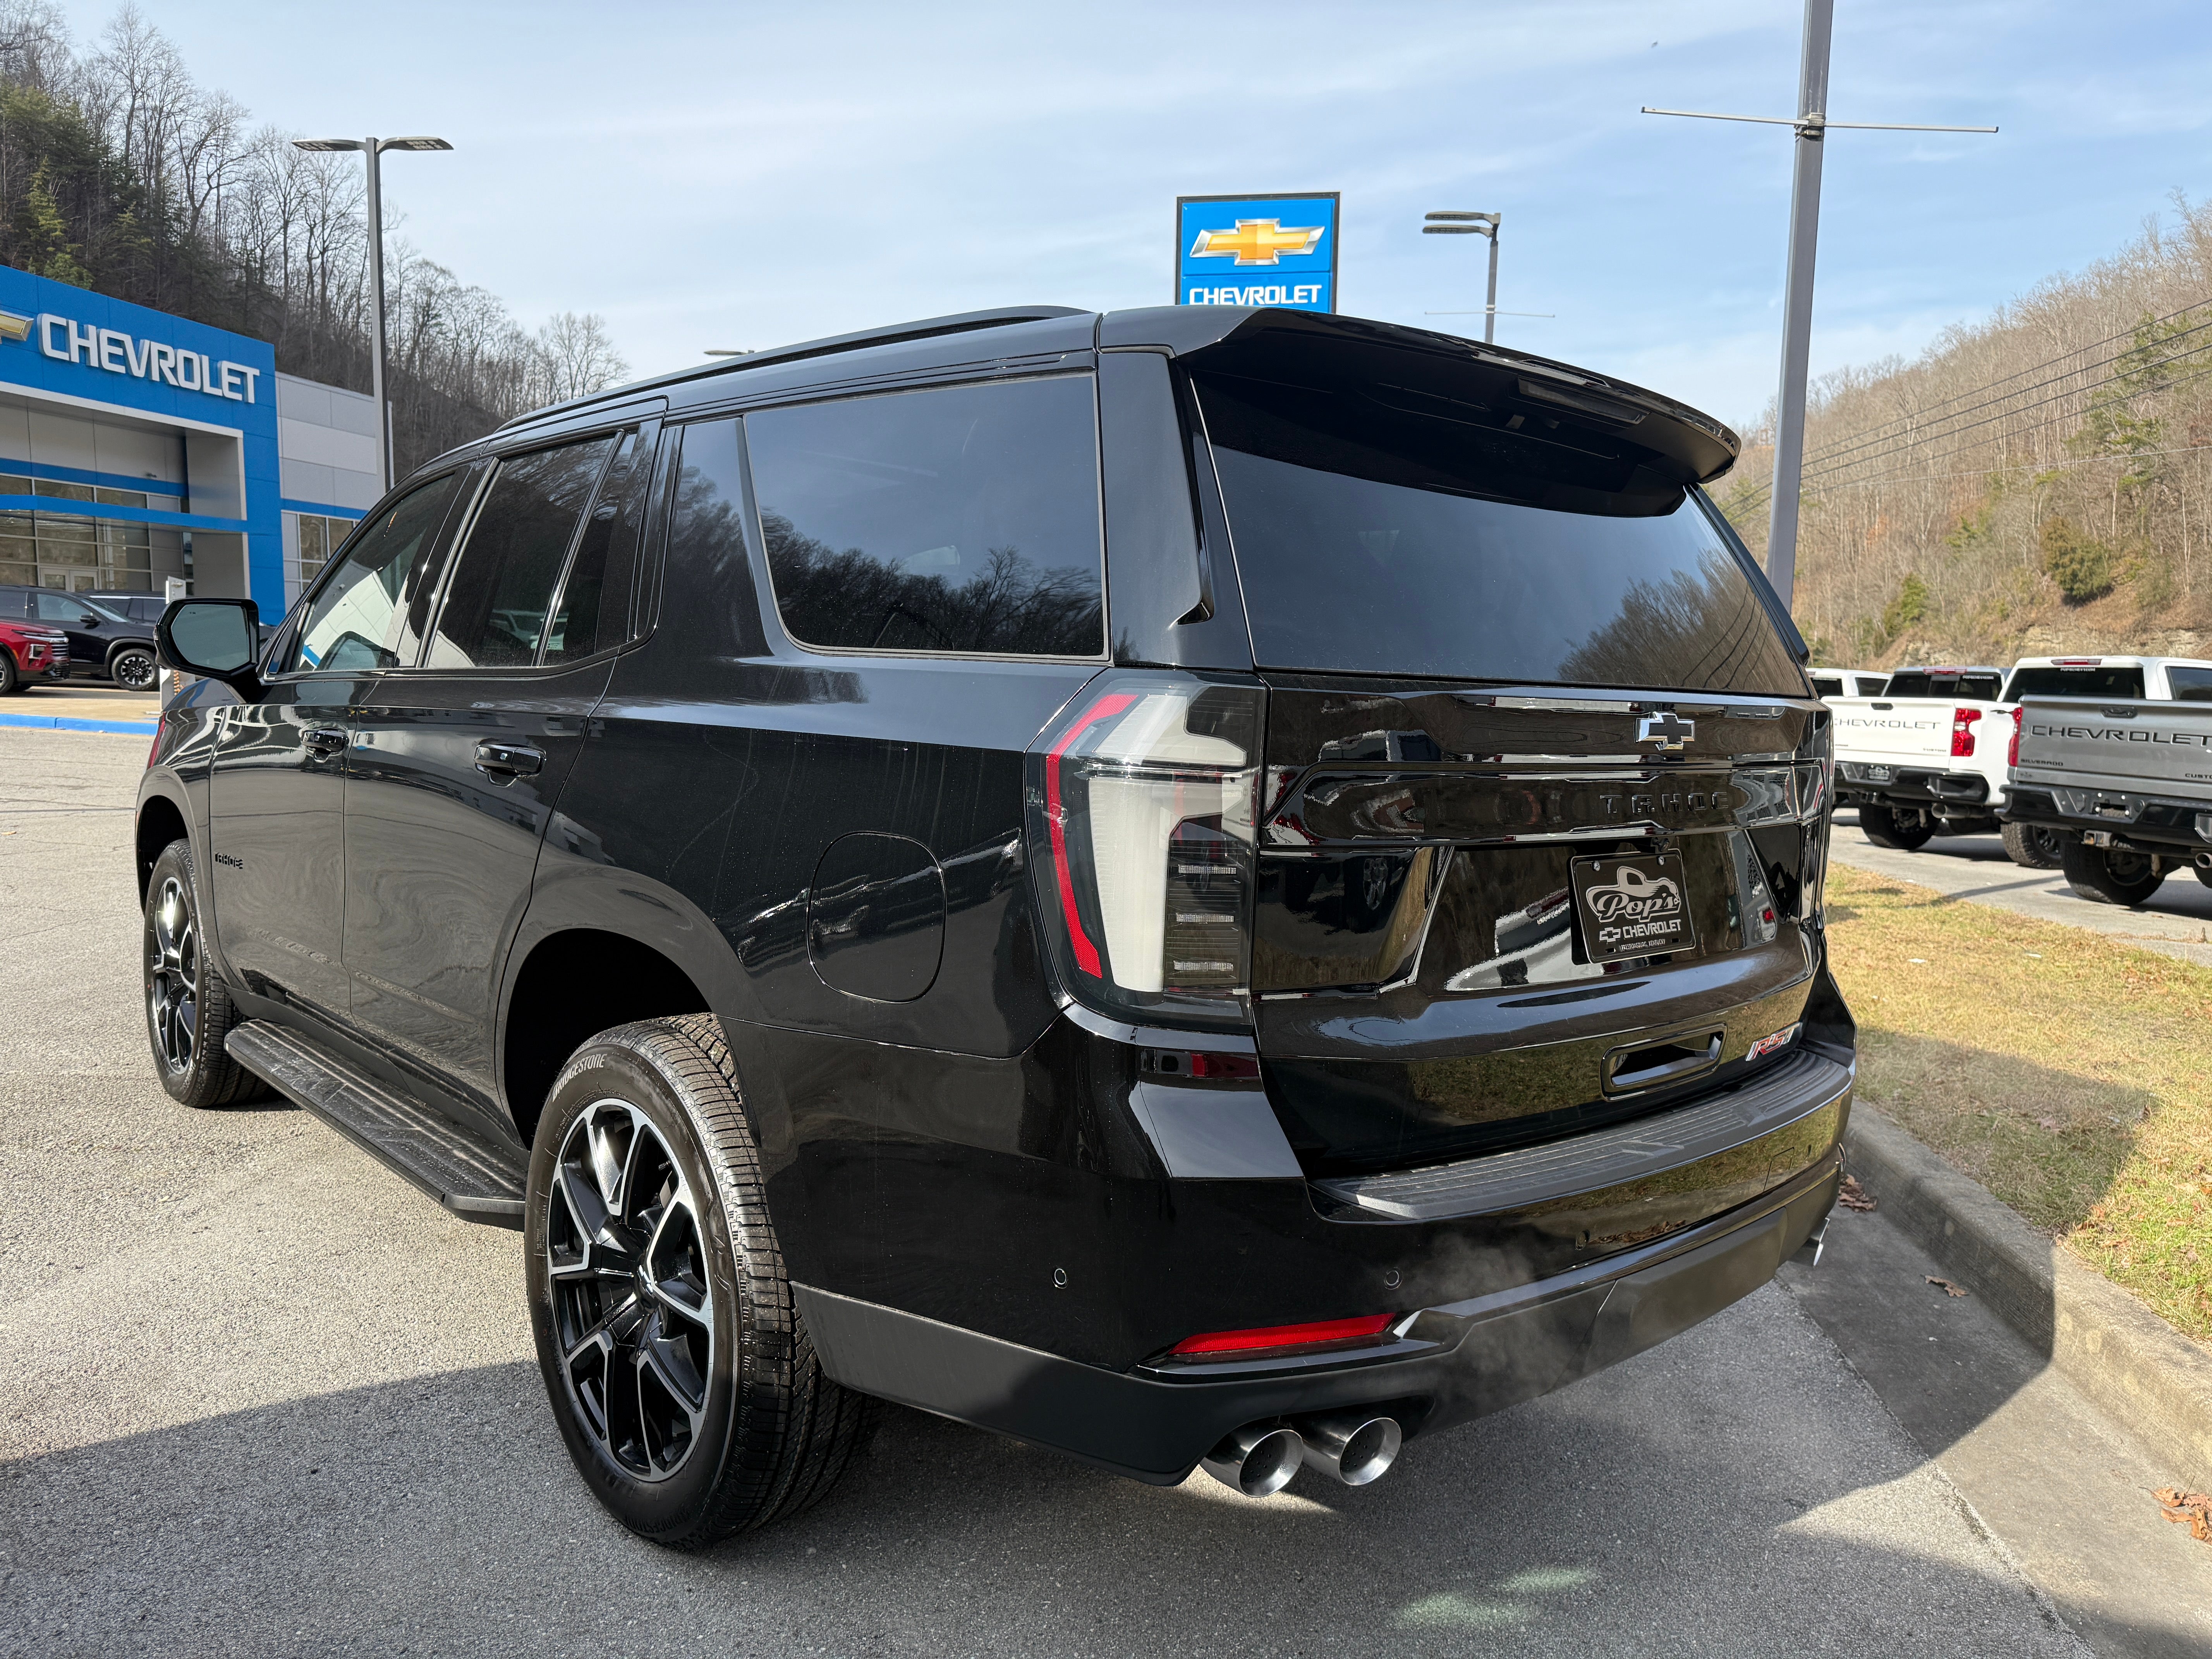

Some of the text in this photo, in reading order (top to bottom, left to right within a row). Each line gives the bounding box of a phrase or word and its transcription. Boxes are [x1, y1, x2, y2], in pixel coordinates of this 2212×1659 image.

[1189, 285, 1322, 306] CHEVROLET
[38, 313, 260, 404] CHEVROLET
[2031, 725, 2212, 747] CHEVROLET
[1599, 792, 1729, 814] TAHOE
[1596, 893, 1679, 917] Pop's
[1622, 919, 1681, 938] CHEVROLET
[1745, 1021, 1803, 1061] RST
[552, 1053, 608, 1103] BRIDGESTONE
